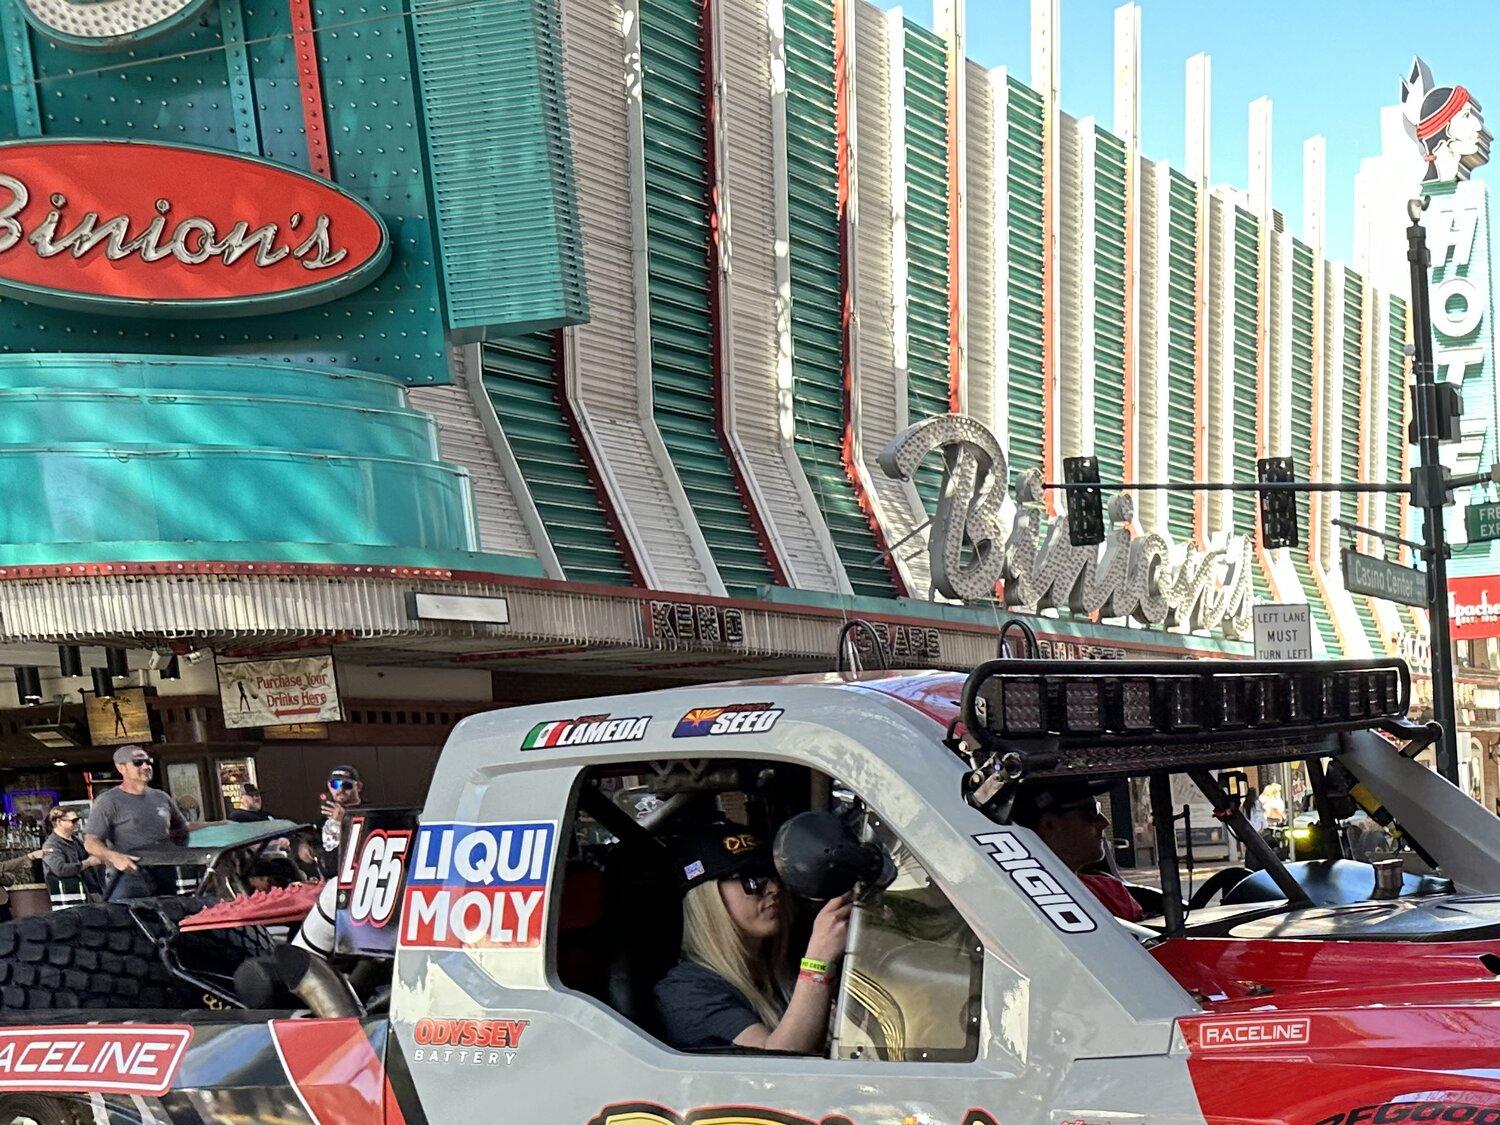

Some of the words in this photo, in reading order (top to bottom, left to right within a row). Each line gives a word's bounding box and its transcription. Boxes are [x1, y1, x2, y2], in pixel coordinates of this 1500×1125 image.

[0, 173, 348, 270] Binion's
[1355, 558, 1385, 590] Casino
[1387, 568, 1414, 599] Center
[650, 600, 745, 643] KENO
[1257, 612, 1279, 624] LEFT
[1283, 611, 1307, 623] LANE
[1267, 629, 1299, 643] MUST
[1259, 649, 1282, 660] TURN
[1287, 648, 1308, 660] LEFT
[257, 674, 302, 690] Purchase
[304, 672, 328, 686] Your
[266, 694, 299, 708] Drinks
[301, 691, 328, 705] Here
[709, 709, 784, 735] SEED
[414, 829, 558, 885] LIQUI
[970, 831, 1098, 934] RIGID
[407, 890, 544, 943] MOLY
[413, 1018, 526, 1048] ODYSSEY
[1205, 1023, 1305, 1043] RACELINE
[0, 1041, 172, 1077] ACELINE
[413, 1049, 517, 1066] BATTERY
